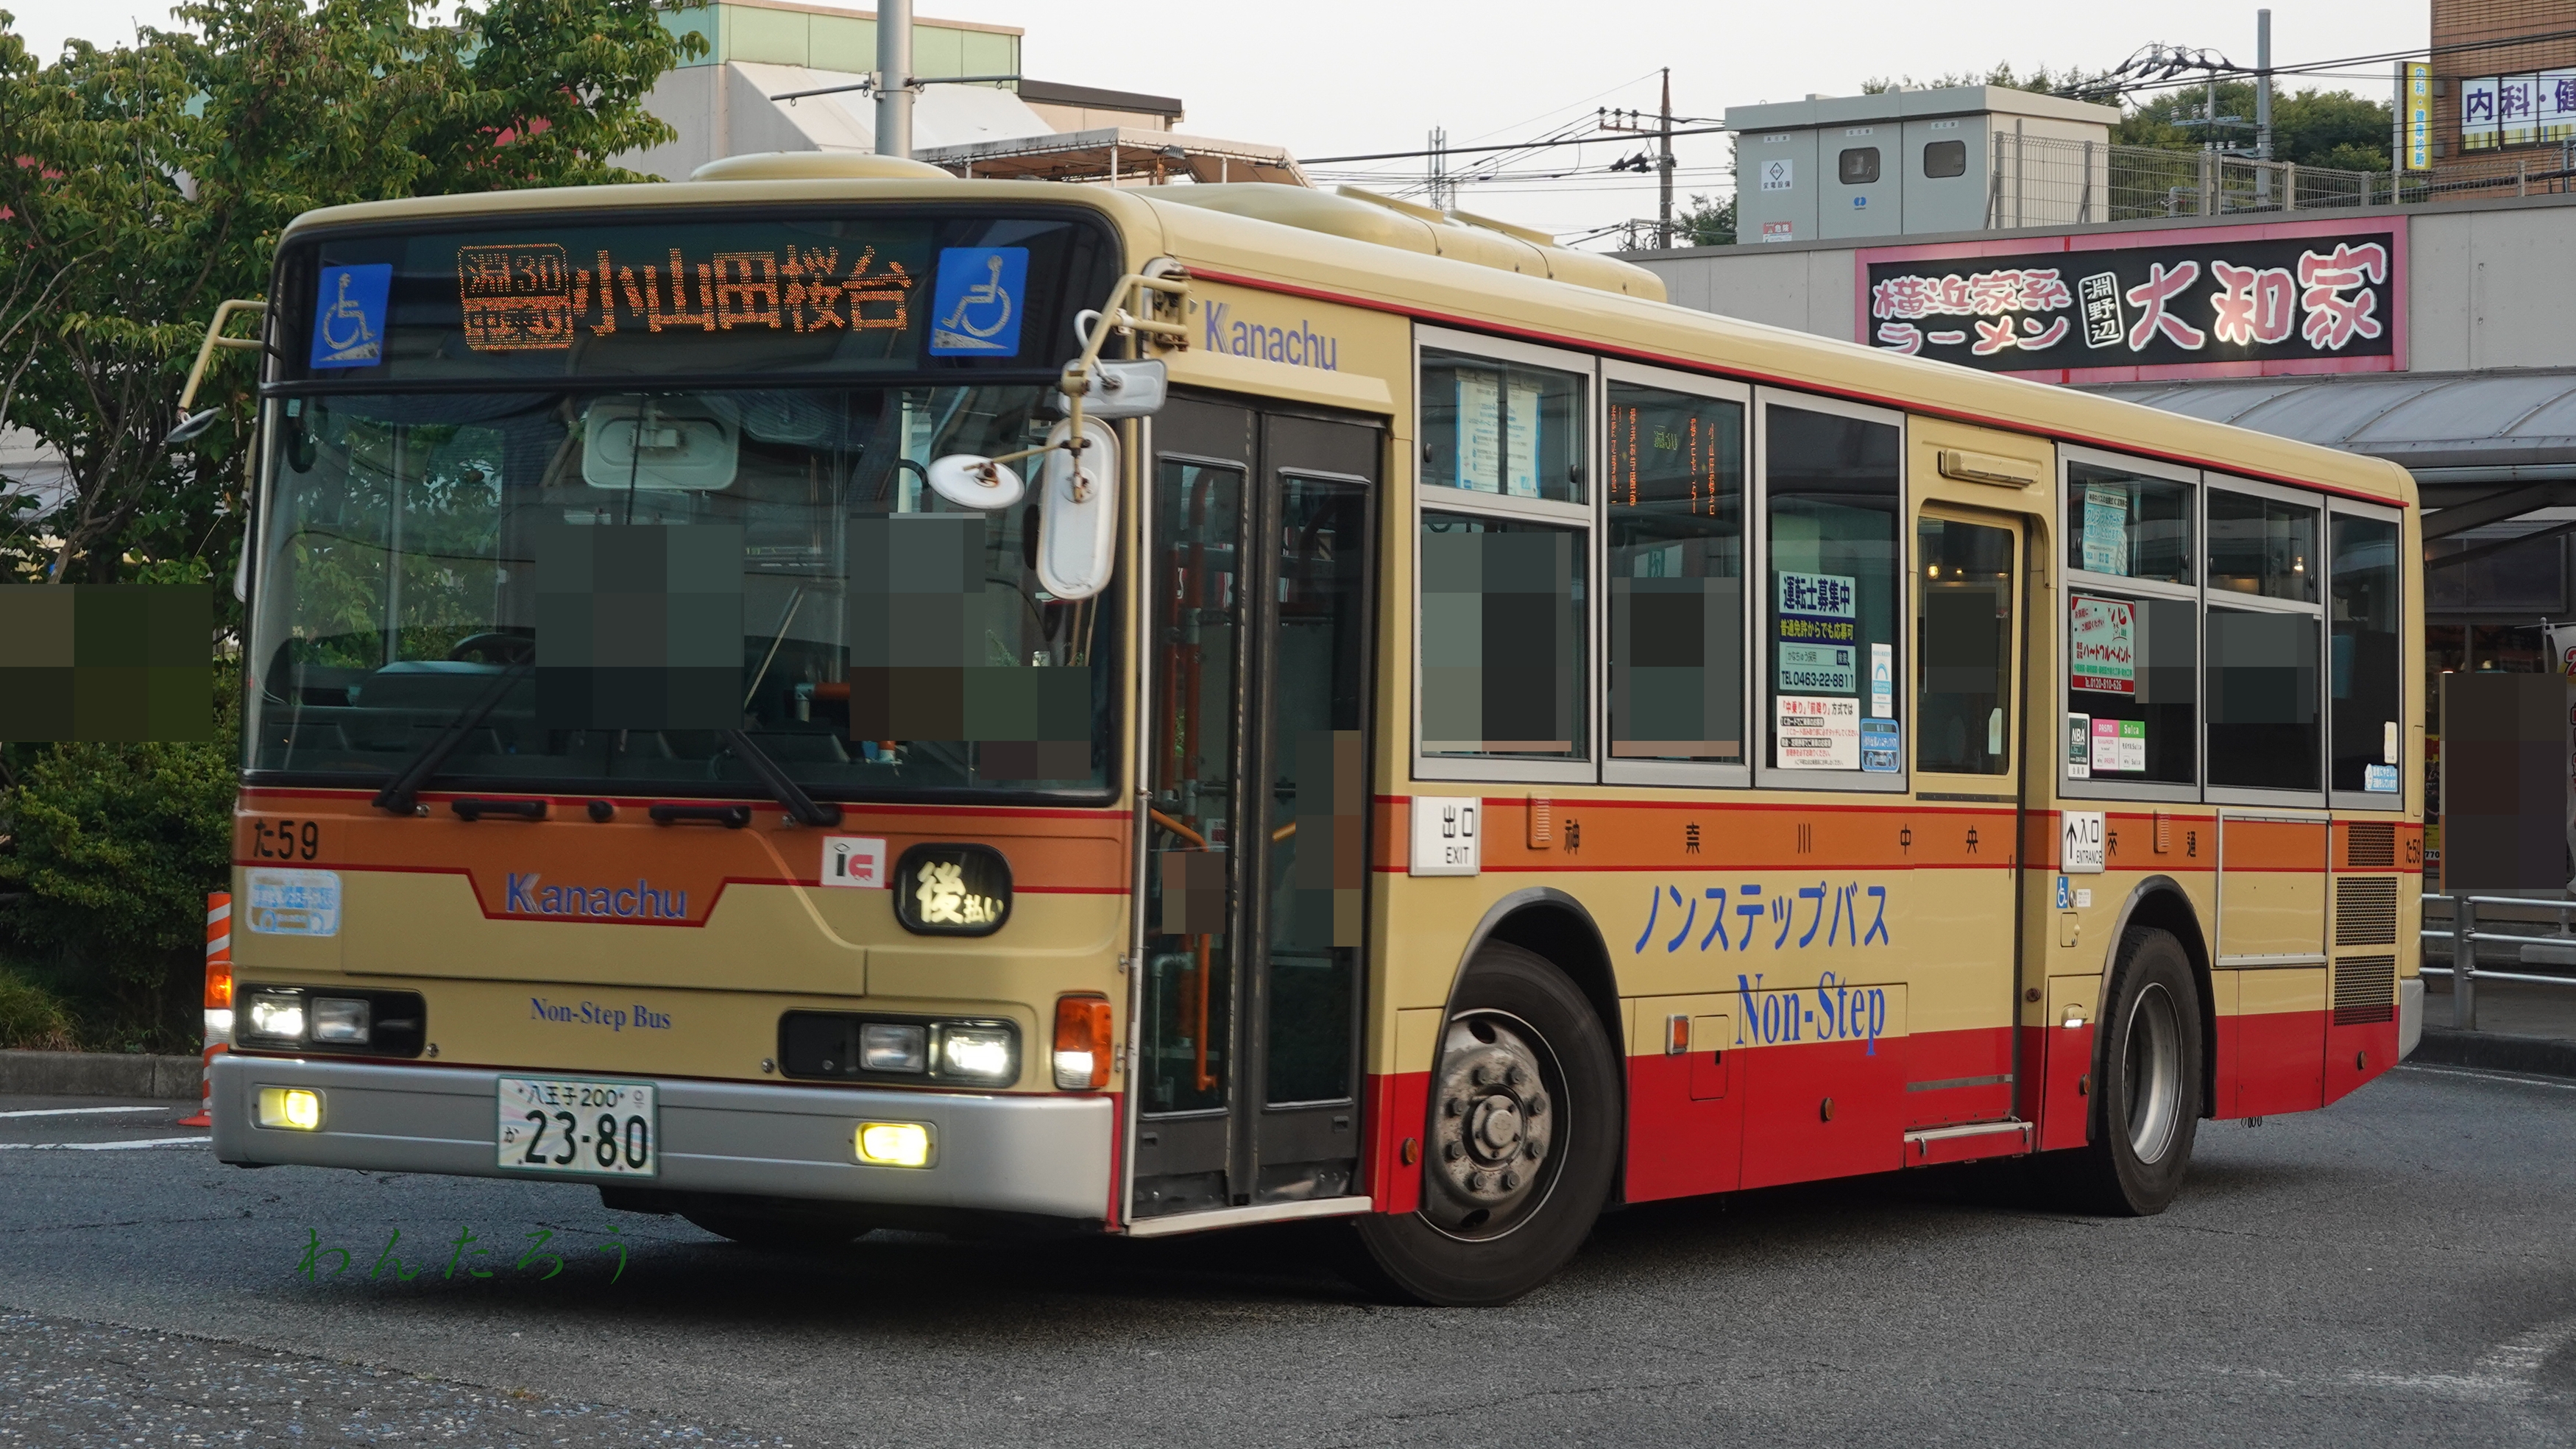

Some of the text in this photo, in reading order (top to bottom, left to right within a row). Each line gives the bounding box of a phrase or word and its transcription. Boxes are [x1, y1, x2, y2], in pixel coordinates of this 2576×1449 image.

[2415, 68, 2426, 166] 内科・健康診断
[1775, 224, 1789, 233] 危険
[572, 245, 913, 337] 小山田桜台
[1874, 266, 2070, 320] 横浜家系
[2128, 241, 2388, 352] 大和家
[1205, 300, 1337, 371] Kanachu
[1876, 314, 2070, 356] ラーメン
[1783, 575, 1850, 614] 運転士募集中
[2083, 643, 2131, 664] ハートフルペイント
[1781, 670, 1854, 688] TEL 0463-22-8811
[2071, 728, 2086, 743] NBA
[2123, 724, 2140, 735] Suica
[253, 818, 319, 861] た59
[1443, 804, 1474, 838] 出口
[2079, 818, 2099, 844] 入口
[1446, 846, 1469, 865] EXIT
[2076, 850, 2102, 864] ENTRANCE
[2405, 837, 2421, 864] た59
[505, 872, 687, 919] Kanachu
[916, 860, 1005, 924] 後払い
[1635, 880, 1889, 954] ノンステップバス
[530, 997, 672, 1032] Non-Step Bus
[1735, 971, 1886, 1056] Non-Step
[526, 1110, 647, 1169] 23-80
